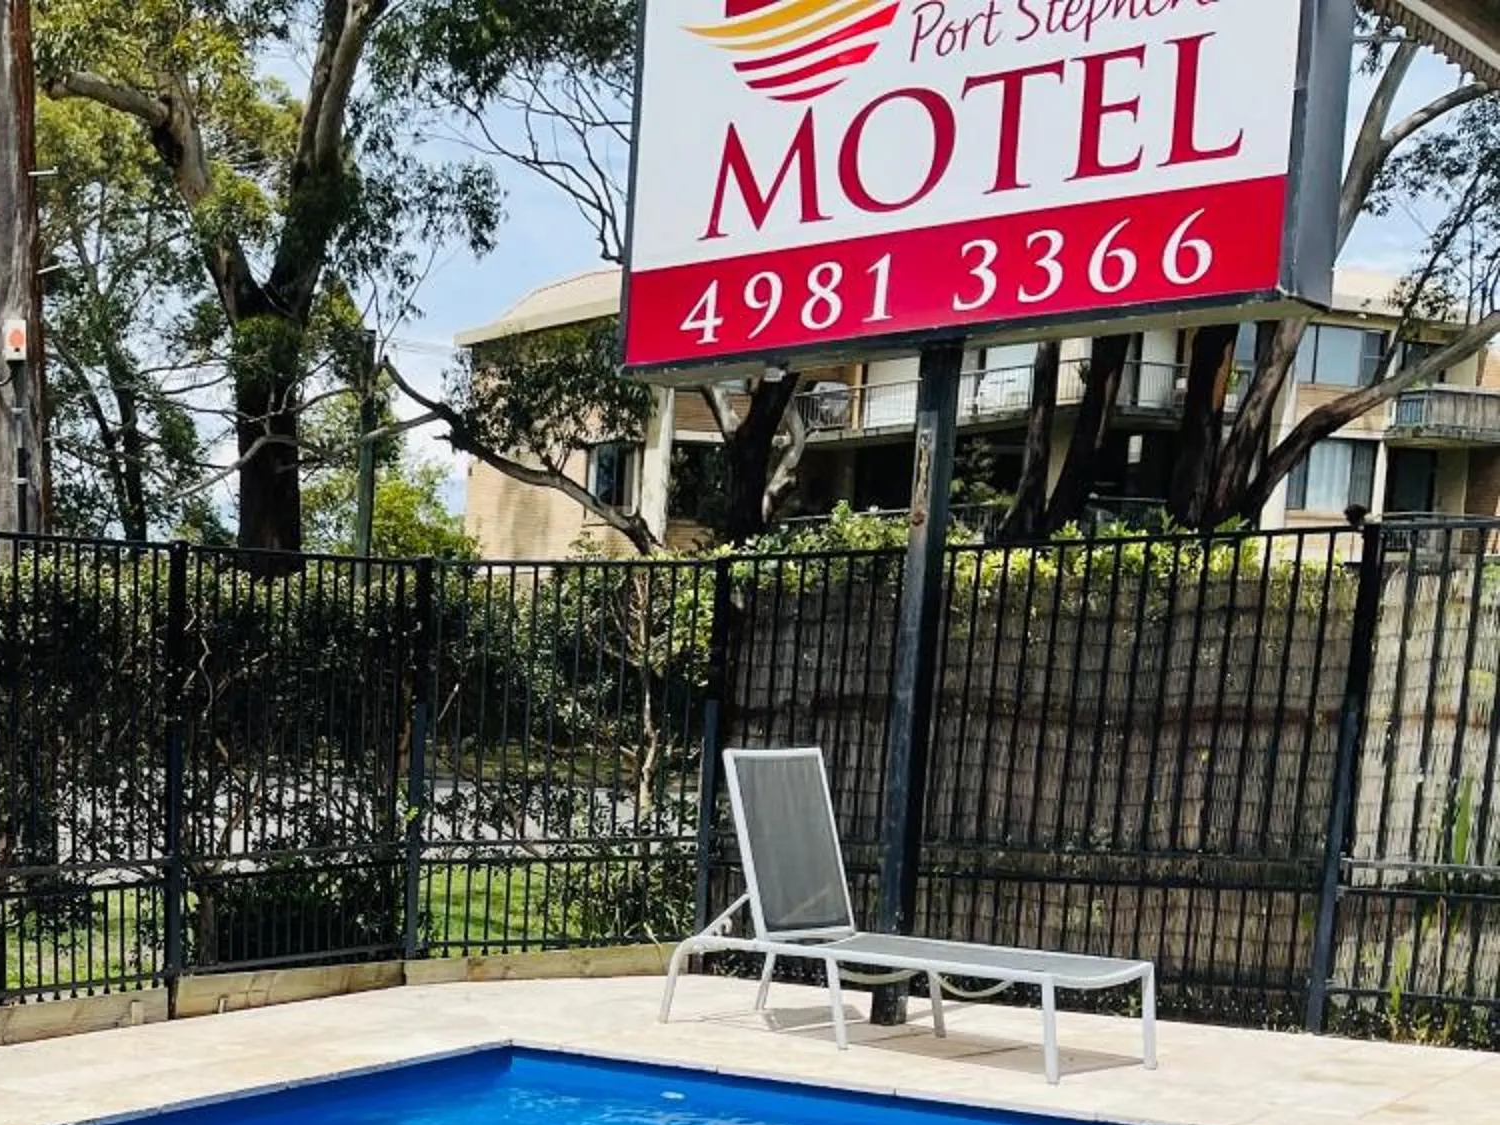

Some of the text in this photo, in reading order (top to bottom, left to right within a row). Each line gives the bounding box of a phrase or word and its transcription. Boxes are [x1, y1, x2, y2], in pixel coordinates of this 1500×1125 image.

[909, 0, 1002, 63] Port
[697, 31, 1244, 241] MOTEL
[678, 207, 1214, 346] 4981 3366
